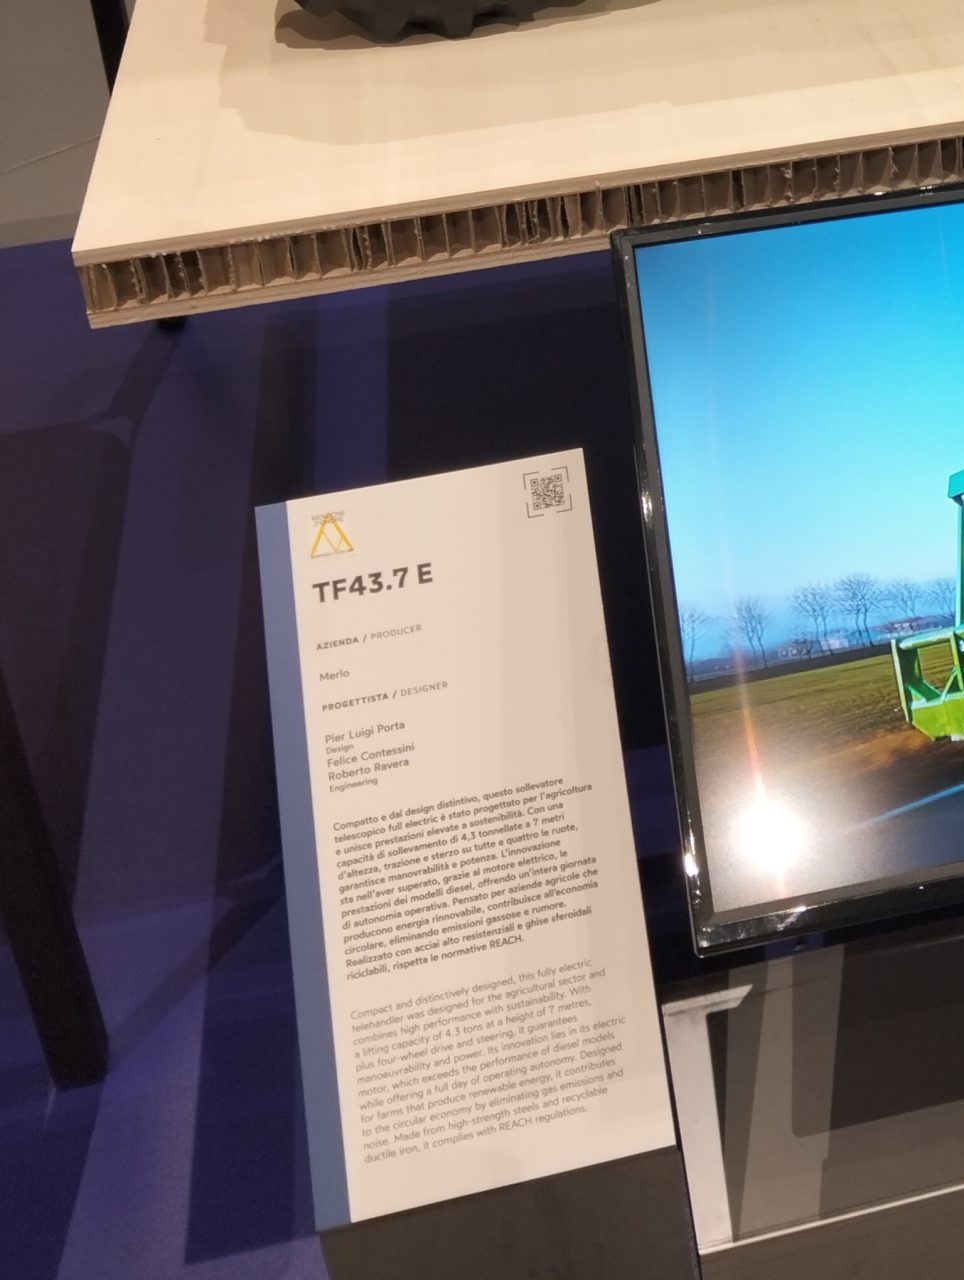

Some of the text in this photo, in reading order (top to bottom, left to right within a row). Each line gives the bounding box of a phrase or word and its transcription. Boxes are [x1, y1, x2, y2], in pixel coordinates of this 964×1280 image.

[311, 561, 433, 604] TF43.7 E
[316, 635, 359, 650] AZIENDA
[370, 623, 421, 640] PRODUCER
[319, 668, 350, 682] Merlo
[322, 692, 388, 712] PROGETTISTA
[400, 680, 447, 696] DESIGNER
[324, 721, 405, 744] Pier Luigi Porta
[325, 744, 353, 754] Design
[327, 741, 414, 768] Felice Contessini
[328, 758, 409, 782] Roberto Ravera
[329, 777, 378, 793] Engineering
[333, 816, 378, 831] Compatto
[388, 809, 402, 819] dal
[404, 804, 434, 816] design
[482, 788, 513, 802] questo
[515, 777, 563, 793] sollevatore
[334, 826, 386, 843] telescopico
[387, 821, 402, 832] full
[404, 814, 437, 828] electric
[440, 812, 446, 821] è
[448, 809, 471, 819] stato
[473, 798, 520, 816] progettato
[522, 795, 537, 805] per
[336, 852, 374, 868] capacità
[376, 850, 385, 859] di
[387, 839, 447, 857] sollevamento
[449, 834, 458, 844] di
[461, 830, 475, 841] 4,3
[478, 823, 522, 838] tonnellate
[532, 817, 538, 826] 7
[541, 812, 564, 824] metri
[343, 842, 372, 854] unisce
[374, 829, 424, 849] prestazioni
[426, 824, 459, 836] elevate
[526, 806, 545, 815] Con
[547, 802, 563, 811] una
[383, 857, 421, 871] trazione
[431, 849, 459, 860] sterzo
[461, 846, 472, 854] su
[474, 841, 496, 851] tutte
[506, 832, 539, 846] quattro
[540, 829, 549, 837] le
[338, 877, 385, 895] garantisce
[388, 861, 449, 882] manovrabilità
[339, 897, 354, 905] sta
[442, 870, 470, 885] grazie
[472, 867, 481, 877] al
[482, 862, 515, 874] motore
[559, 849, 568, 858] le
[341, 899, 391, 920] prestazioni
[393, 895, 408, 906] dei
[410, 888, 443, 903] modelli
[477, 873, 516, 888] offrendo
[559, 857, 596, 872] giornata
[342, 920, 350, 930] di
[353, 910, 401, 927] autonomia
[452, 892, 488, 906] Pensato
[490, 889, 505, 900] per
[508, 879, 542, 894] aziende
[545, 871, 580, 886] agricole
[582, 867, 598, 877] che
[343, 926, 393, 945] producono
[395, 917, 429, 931] energia
[487, 894, 541, 911] contribuisce
[346, 952, 392, 968] Realizzato
[395, 947, 411, 957] con
[414, 939, 439, 952] acciai
[442, 936, 459, 946] alto
[462, 922, 514, 942] resistenziali
[525, 917, 548, 930] ghise
[551, 905, 591, 922] sferoidali
[389, 928, 439, 945] eliminando
[441, 917, 483, 934] emissioni
[485, 911, 521, 926] gassose
[392, 957, 429, 970] rispetta
[429, 953, 439, 962] le
[440, 943, 487, 960] normative
[350, 1004, 392, 1020] Compact
[395, 998, 413, 1010] and
[414, 986, 470, 1006] distinctively
[518, 971, 535, 982] this
[536, 967, 557, 978] fully
[558, 959, 592, 973] electric
[351, 967, 605, 1033] telehandler was designed for the agricultural sector and
[356, 1062, 431, 1085] manoeuvrability
[433, 1055, 451, 1067] and
[487, 1046, 499, 1055] Its
[501, 1035, 548, 1051] innovation
[550, 1031, 566, 1040] lies
[568, 1027, 577, 1036] in
[579, 1025, 590, 1033] its
[592, 1016, 625, 1030] electric
[364, 1149, 397, 1164] ductile
[422, 1140, 429, 1150] it
[431, 1131, 474, 1147] complies
[475, 1124, 496, 1137] with
[498, 1115, 532, 1131] REACH
